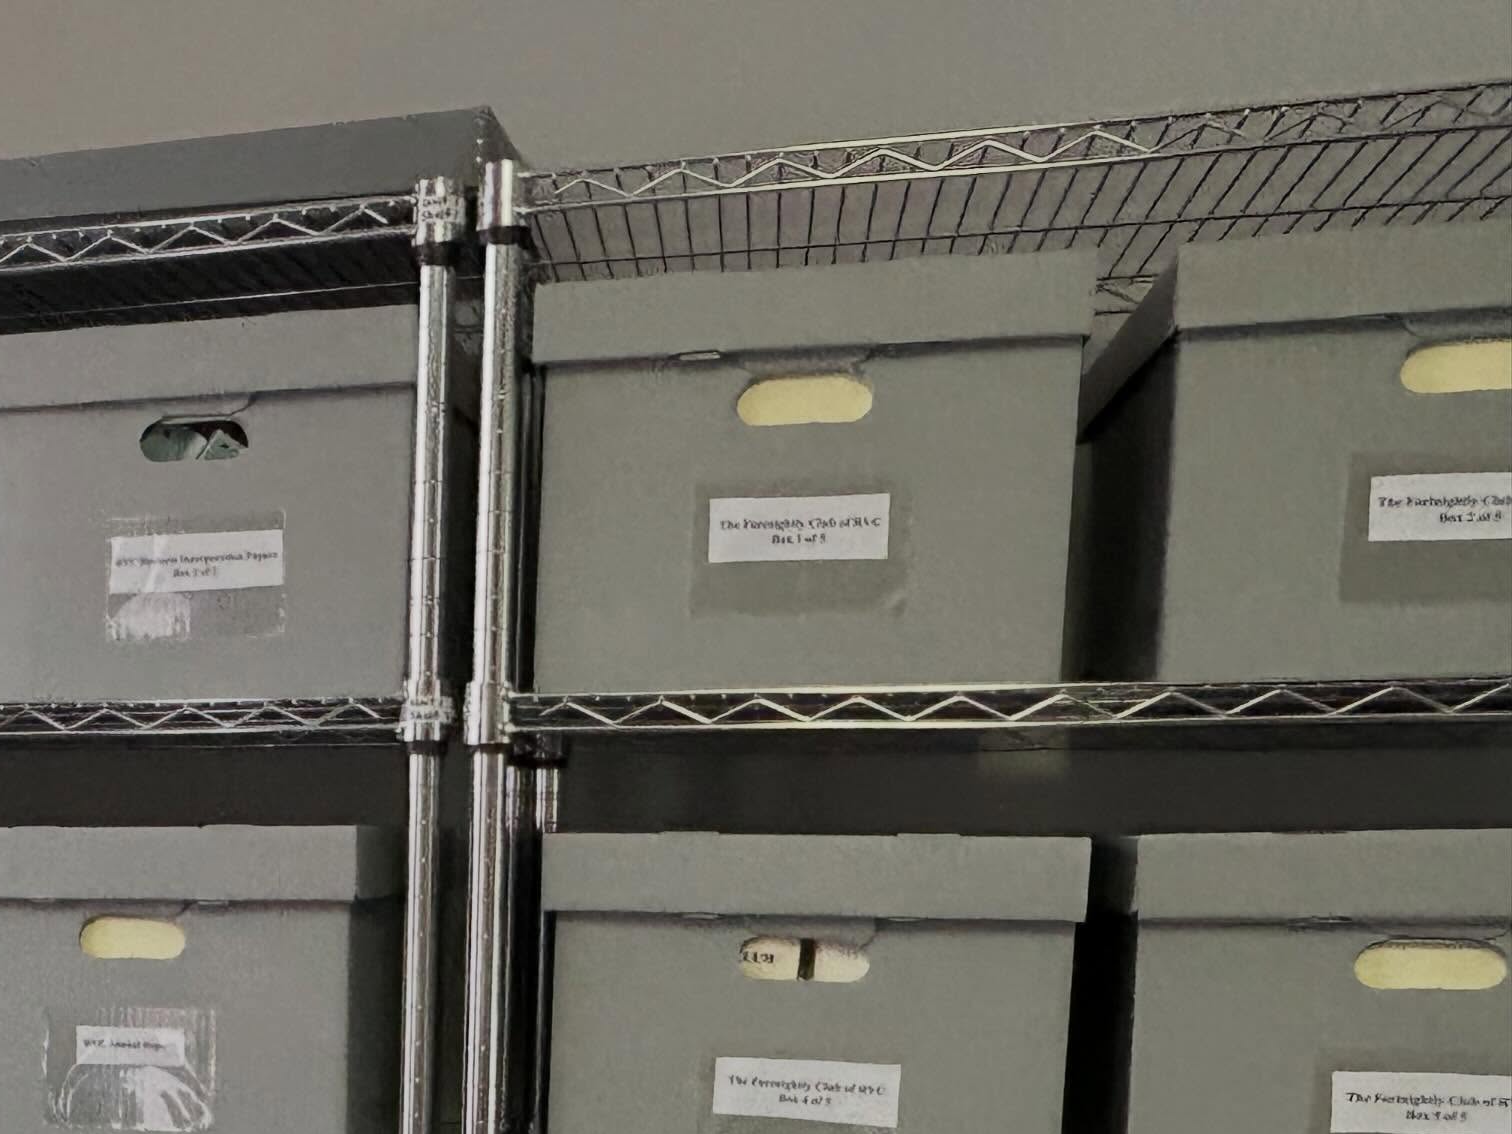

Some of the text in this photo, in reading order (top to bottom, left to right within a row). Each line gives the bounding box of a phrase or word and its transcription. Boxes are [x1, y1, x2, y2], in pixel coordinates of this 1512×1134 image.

[1377, 495, 1402, 508] The
[1405, 494, 1479, 510] Fortnightly
[719, 519, 740, 531] The
[742, 517, 805, 533] Fortnightly
[807, 517, 837, 530] Club
[771, 533, 794, 545] Box
[803, 533, 817, 544] of
[728, 1073, 748, 1087] The
[750, 1075, 811, 1093] Fortnightly
[778, 1093, 800, 1105] Box
[1344, 1091, 1372, 1104] The
[1374, 1092, 1445, 1108] Fortnightly
[1448, 1095, 1481, 1108] Club
